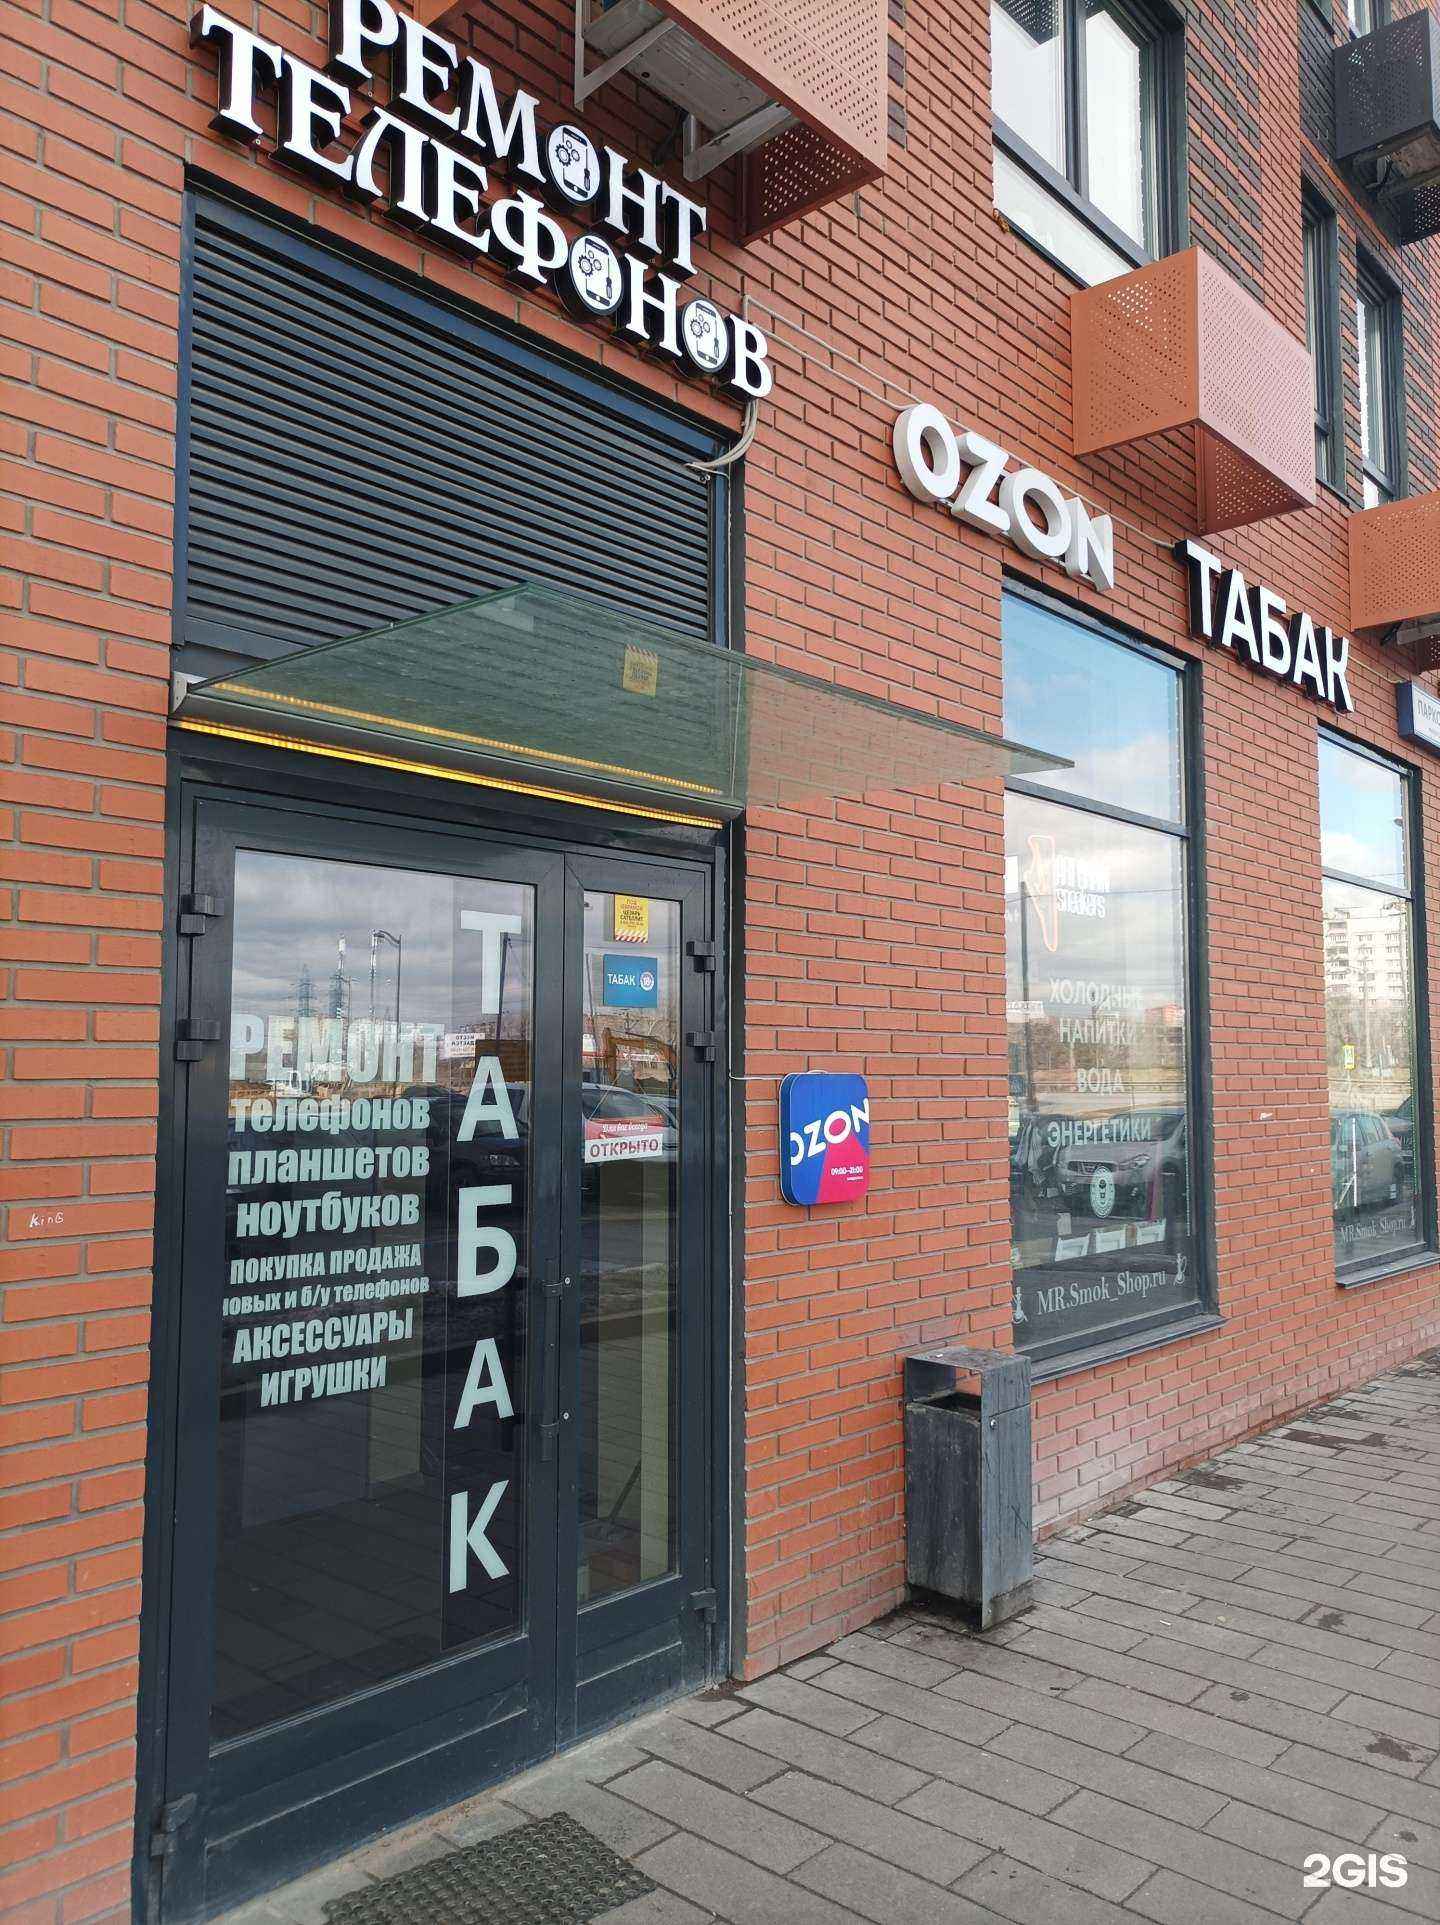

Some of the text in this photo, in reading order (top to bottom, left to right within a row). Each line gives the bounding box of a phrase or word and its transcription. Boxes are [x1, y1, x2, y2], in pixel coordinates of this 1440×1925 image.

[334, 0, 707, 275] РЕМОНТ
[202, 8, 773, 398] ТЕЛЕФОНОВ
[893, 403, 1114, 593] OZON
[1187, 539, 1355, 713] ТАБАК
[607, 973, 636, 986] ТАБАК
[1050, 978, 1143, 1010] ХОЛОДНЫЕ
[229, 1013, 445, 1083] РЕМОНТ
[1059, 1017, 1136, 1045] НАПИТКИ
[1076, 1068, 1125, 1095] ВОДА
[231, 1095, 430, 1134] телефонов
[1047, 1118, 1151, 1147] ЭНЕРГЕТИКИ
[228, 1146, 430, 1185] планшетов
[590, 1139, 659, 1158] ОТКРЫТО
[236, 1191, 421, 1239] ноутбуков
[230, 1244, 422, 1284] ПОКУПКА ПРОДАЖА
[449, 910, 522, 1594] ТАБАК
[284, 1290, 297, 1309] и
[300, 1284, 331, 1310] б/у
[333, 1276, 430, 1303] телефонов
[232, 1308, 414, 1364] АКСЕССУАРЫ
[260, 1355, 387, 1408] ИГРУШКИ
